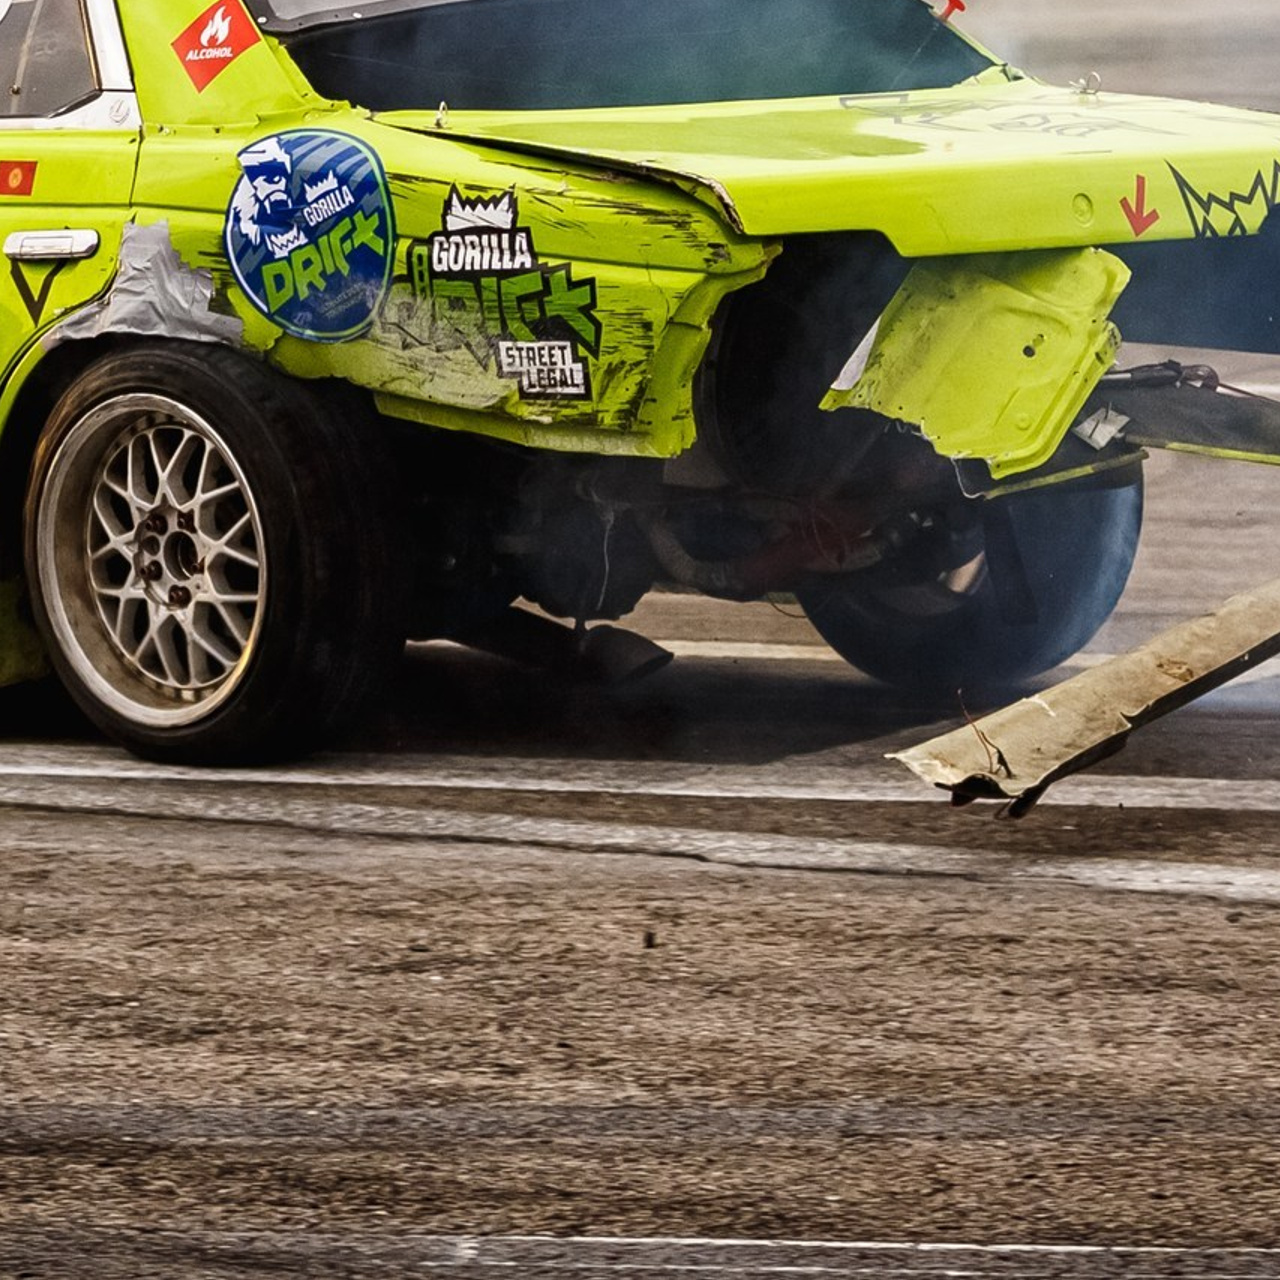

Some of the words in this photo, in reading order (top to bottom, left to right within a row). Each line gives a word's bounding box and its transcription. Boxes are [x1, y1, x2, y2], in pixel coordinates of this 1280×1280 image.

[185, 46, 233, 61] ALCOHOL
[303, 185, 354, 226] GORILLA
[432, 232, 532, 272] GORILLA
[505, 344, 568, 367] STREET
[527, 365, 579, 389] LEGAL
